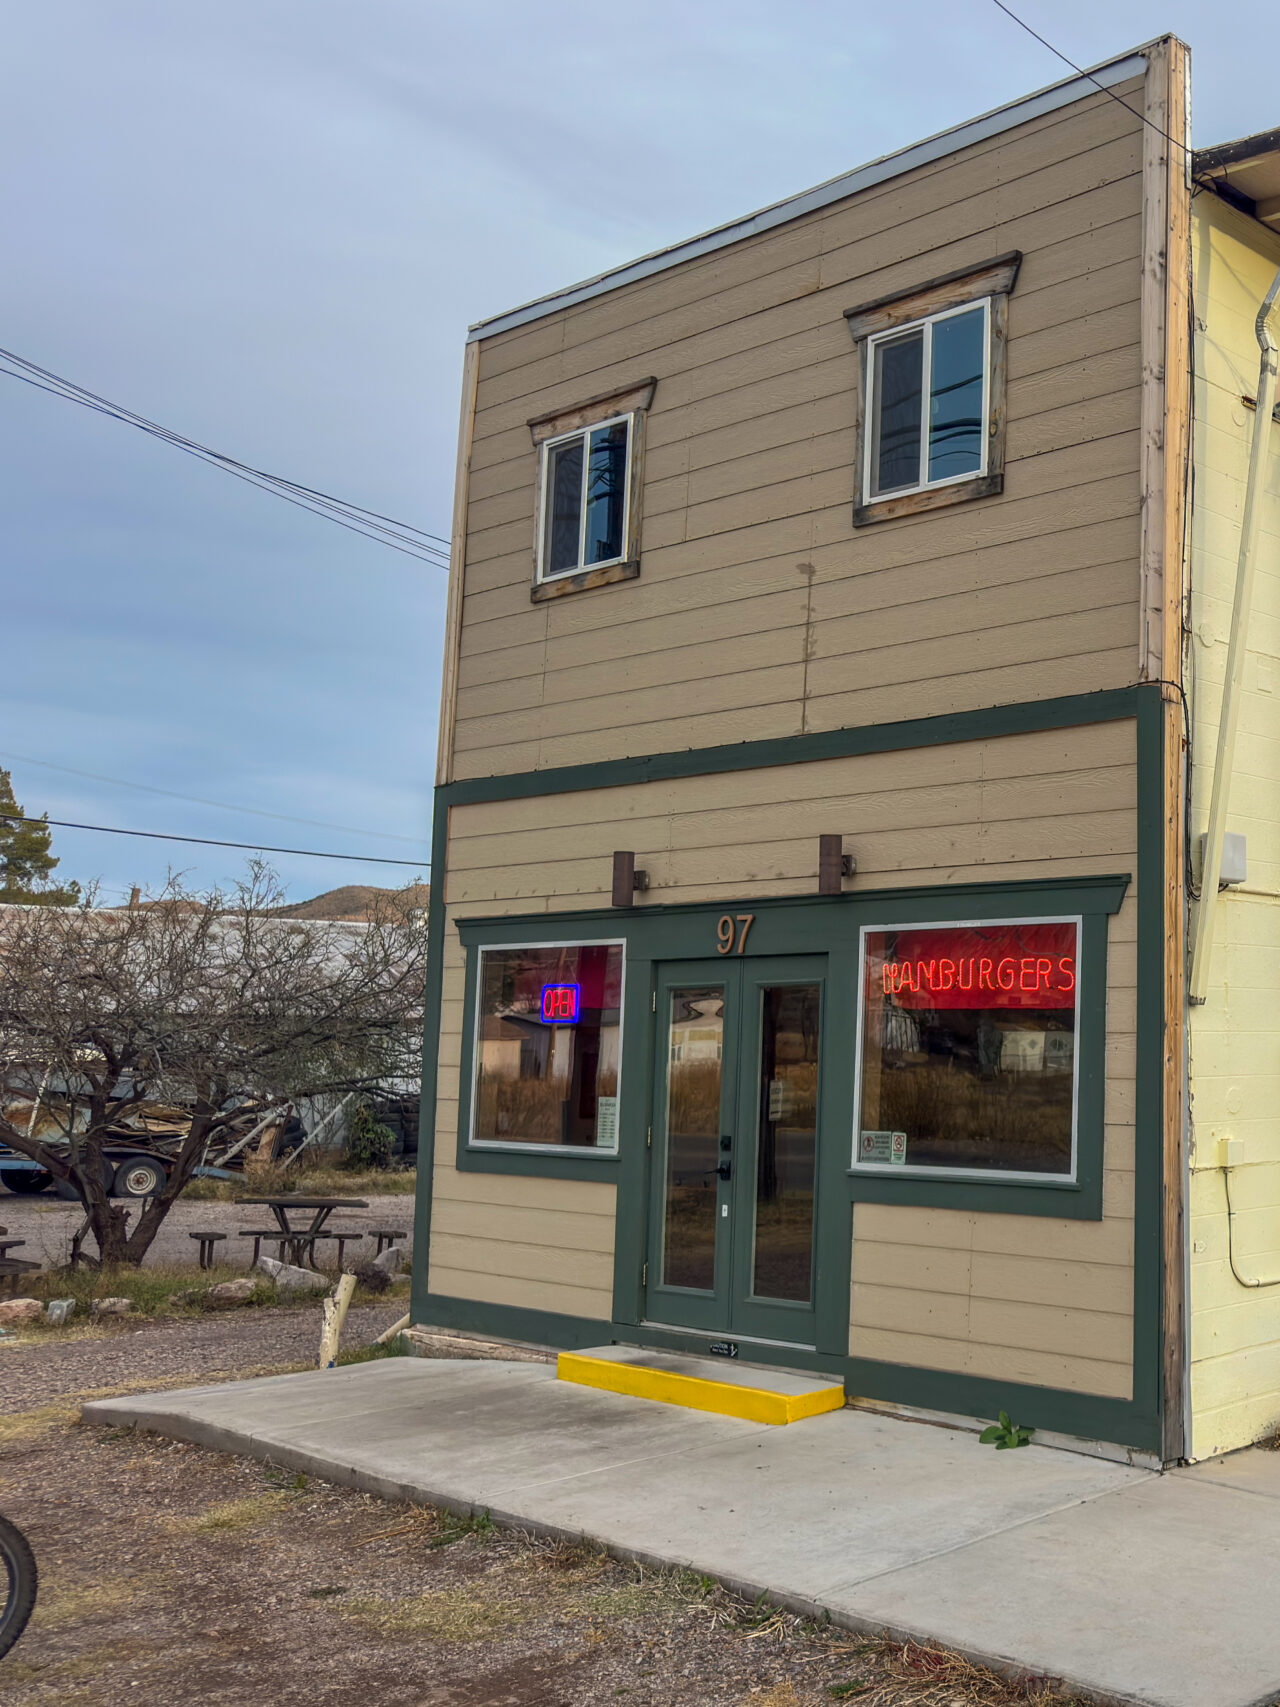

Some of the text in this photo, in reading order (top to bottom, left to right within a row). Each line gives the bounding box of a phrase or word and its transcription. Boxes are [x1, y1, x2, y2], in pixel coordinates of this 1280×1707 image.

[717, 914, 754, 954] 97
[882, 957, 1075, 994] HAMBURGERS
[543, 989, 577, 1017] OPEN
